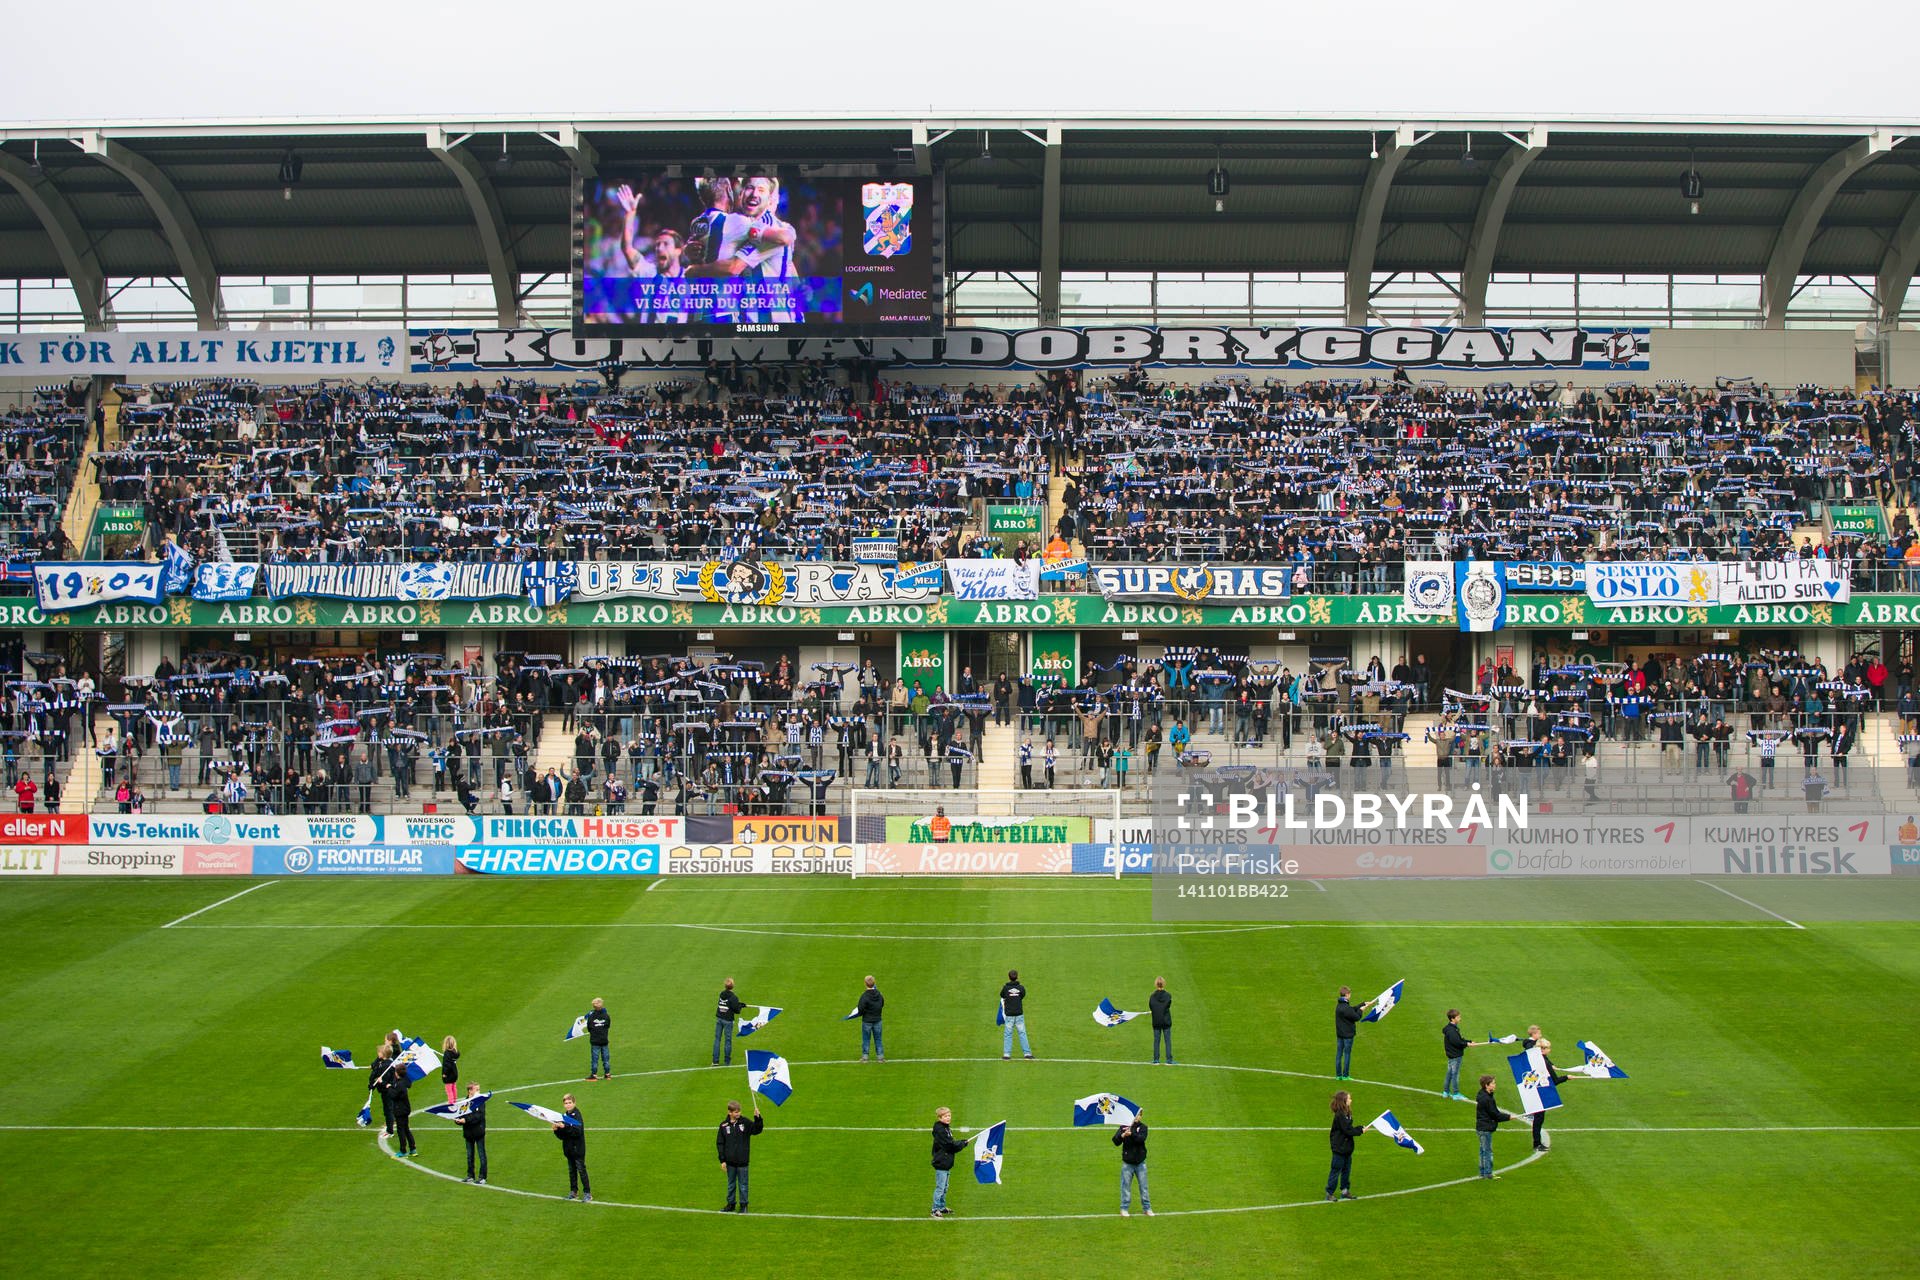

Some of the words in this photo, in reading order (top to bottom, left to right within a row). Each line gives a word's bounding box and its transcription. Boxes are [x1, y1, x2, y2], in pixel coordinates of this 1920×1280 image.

[641, 284, 655, 295] VI
[690, 284, 719, 295] HUR
[723, 284, 742, 295] DU
[746, 284, 790, 295] HALTA
[879, 288, 928, 300] Mediatec
[635, 298, 650, 309] VI
[684, 298, 713, 309] HUR
[717, 298, 737, 309] DU
[740, 298, 796, 309] SPRANG
[736, 324, 780, 333] SAMSUNG
[39, 334, 115, 364] FÖR
[129, 341, 224, 363] ALLT
[236, 340, 366, 363] KJETIL
[994, 517, 1026, 529] ÅBRO
[1834, 518, 1865, 530] ÅBRO
[853, 543, 883, 552] SYMPATI
[560, 561, 574, 576] 3
[985, 566, 1006, 580] frid
[1517, 564, 1575, 587] SBB
[1595, 565, 1677, 578] SEKTION
[1799, 560, 1819, 579] PÅ
[268, 564, 399, 598] UPPORTERKLUBBEN
[525, 576, 573, 587] ULTRAS
[957, 580, 1007, 600] Klas
[1100, 568, 1170, 596] SUP
[1213, 569, 1284, 596] RAS
[1596, 577, 1680, 598] OSLO
[1738, 584, 1786, 600] ALLTID
[1795, 583, 1823, 598] SUR
[94, 603, 168, 624] ÅBRO
[217, 603, 292, 624] ÅBRO
[341, 603, 416, 624] ÅBRO
[467, 603, 543, 624] ÅBRO
[592, 603, 669, 624] ÅBRO
[719, 603, 796, 624] ÅBRO
[974, 602, 1052, 624] ÅBRO
[1101, 602, 1178, 624] ÅBRO
[1505, 604, 1560, 623] BRO
[903, 655, 942, 668] ÅBRO
[1033, 657, 1073, 670] ÅBRO
[4, 821, 47, 837] eller
[51, 820, 65, 836] N
[93, 822, 199, 838] VVS-Teknik
[235, 823, 280, 839] Vent
[308, 824, 356, 839] WHC
[407, 824, 454, 839] WHC
[490, 819, 578, 838] FRIGGA
[583, 819, 678, 838] HuseT
[761, 824, 833, 843] JOTUN
[1187, 829, 1248, 844] TYRES
[1309, 828, 1382, 845] KUMHO
[1387, 828, 1447, 845] TYRES
[1507, 828, 1579, 845] KUMHO
[1583, 827, 1645, 844] TYRES
[1704, 827, 1775, 843] KUMHO
[1779, 826, 1839, 843] TYRES
[87, 850, 176, 869] Shopping
[317, 850, 423, 864] FRONTBILAR
[461, 849, 653, 872] EHRENBORG
[669, 858, 753, 873] EKSJÖHUS
[918, 845, 1019, 871] Renova
[1517, 848, 1573, 870] bafab
[1580, 854, 1687, 870] kontorsmöbler
[1723, 846, 1858, 874] Nilfisk
